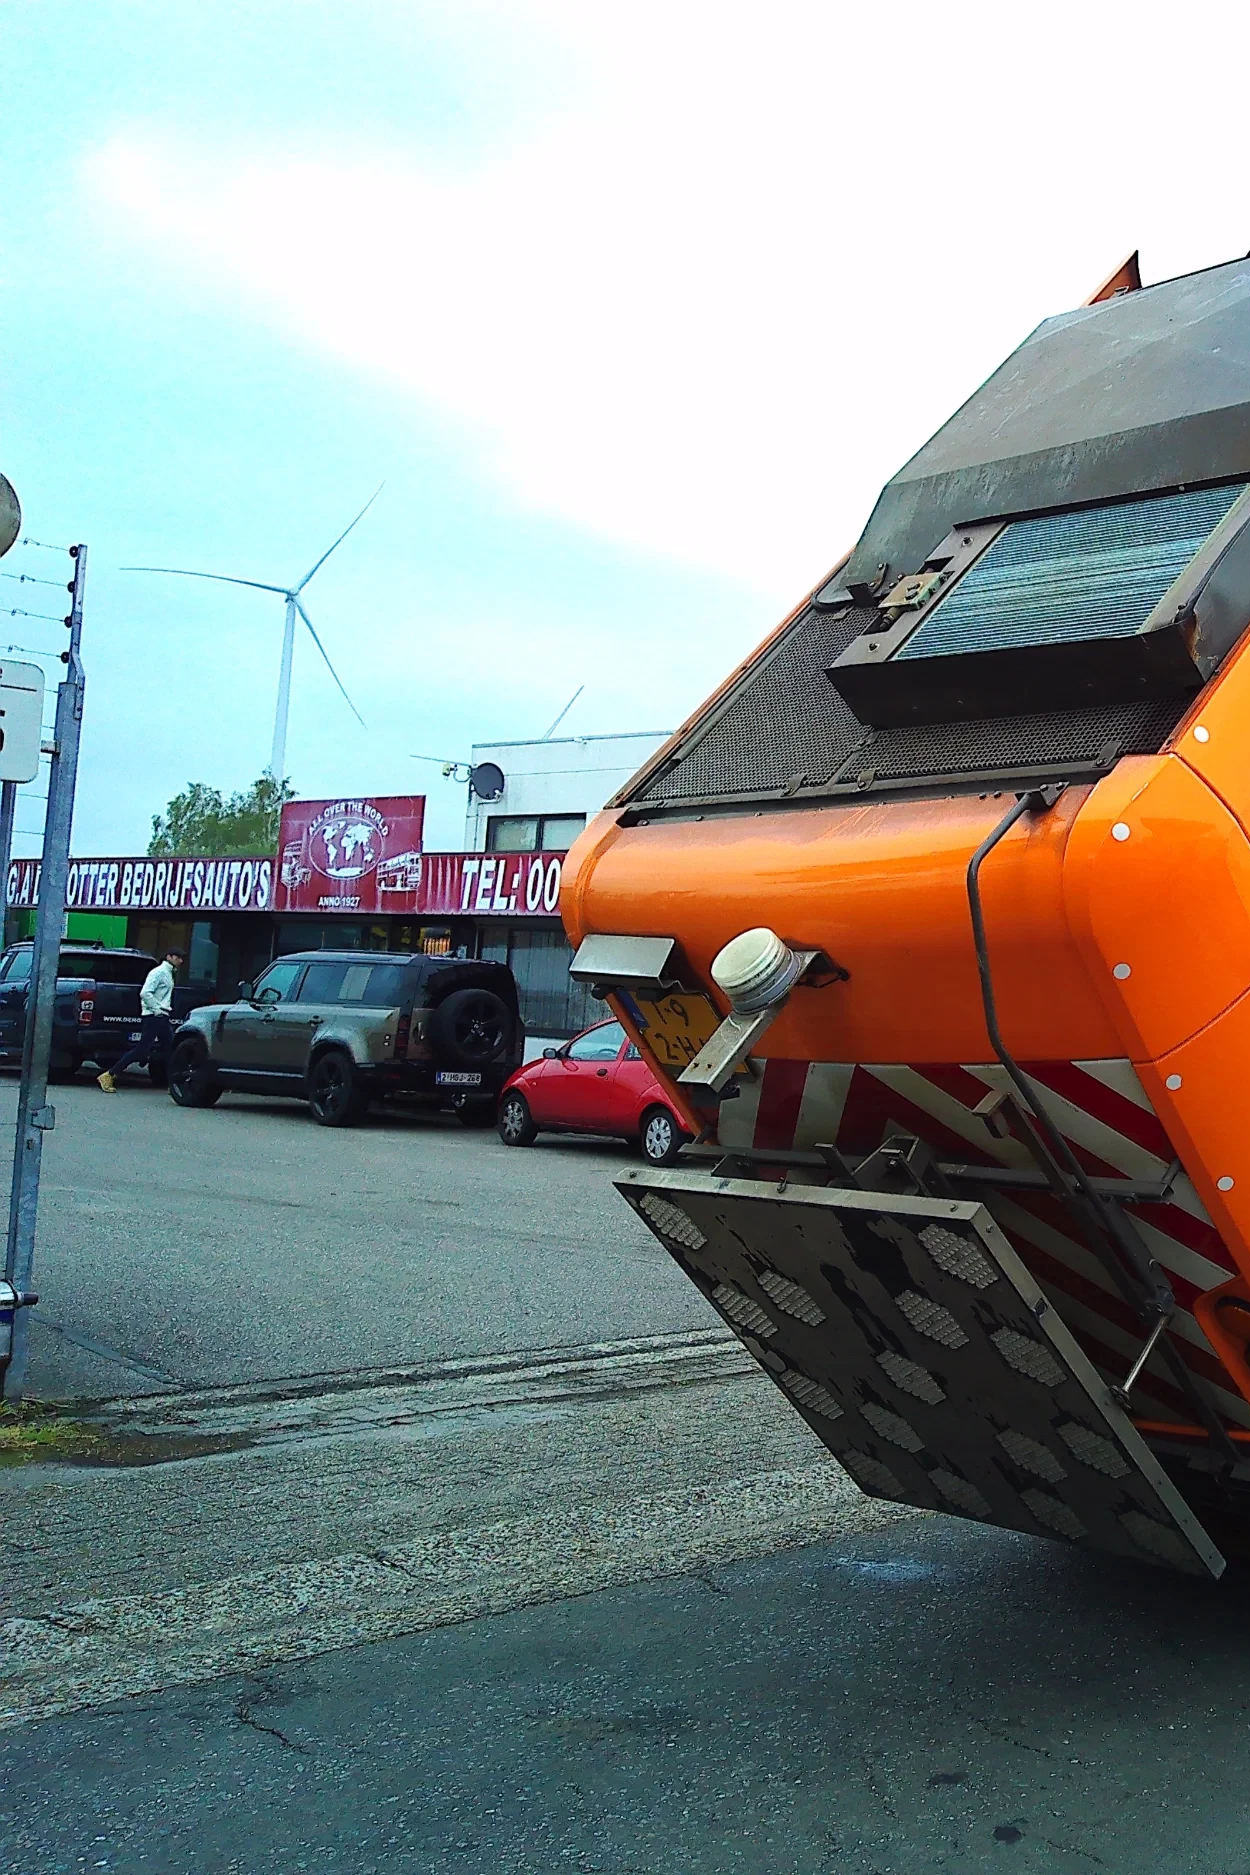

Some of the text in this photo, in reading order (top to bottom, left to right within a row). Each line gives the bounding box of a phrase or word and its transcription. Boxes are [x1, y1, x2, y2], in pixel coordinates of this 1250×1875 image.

[309, 801, 389, 837] ALL OVER THE WORLD
[66, 863, 119, 906] OTTER
[119, 860, 272, 908] BEDRIJFSAUTO'S
[318, 896, 361, 907] ANNO 1927
[461, 859, 520, 910] TEL:
